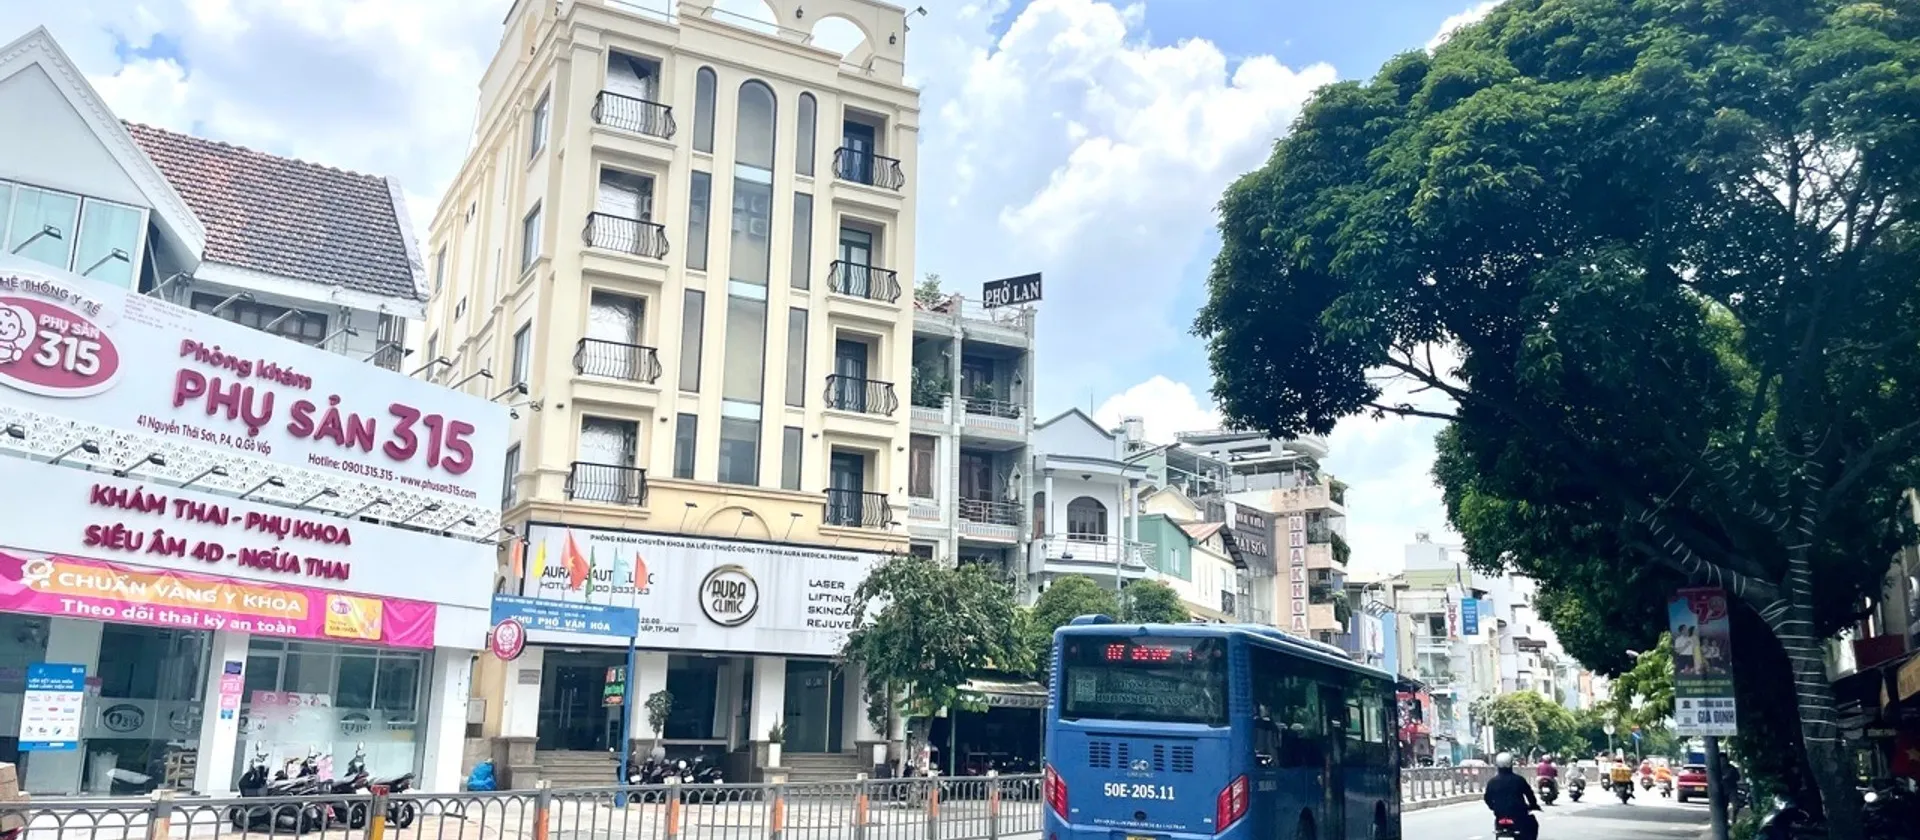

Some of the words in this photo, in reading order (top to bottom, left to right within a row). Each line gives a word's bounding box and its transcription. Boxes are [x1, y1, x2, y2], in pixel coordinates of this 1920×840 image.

[22, 280, 69, 299] THỐNG
[72, 294, 82, 304] Y
[84, 300, 103, 315] TẾ
[985, 280, 1010, 306] PHỞ
[1013, 281, 1039, 301] LAN
[39, 313, 69, 334] PHỤ
[71, 320, 101, 339] SẢN
[33, 330, 101, 376] 315
[179, 338, 252, 378] Phòng
[256, 359, 312, 390] khám
[137, 415, 147, 427] 41
[182, 424, 199, 439] Thái
[256, 440, 272, 456] Vấp
[173, 368, 275, 437] PHỤ
[287, 394, 376, 453] SẢN
[383, 403, 475, 475] 315
[308, 453, 341, 470] Hotline:
[342, 460, 393, 482] 0901.315.315
[400, 475, 477, 499] www.phusan315.com
[90, 483, 166, 517] KHÁM
[173, 499, 229, 526] THAI
[245, 511, 291, 543] PHỤ
[293, 519, 351, 546] KHOA
[83, 522, 143, 552] SIÊU
[148, 529, 188, 557] ÂM
[189, 541, 224, 563] 4D
[304, 558, 350, 581] THAI
[590, 534, 615, 543] PHÒNG
[616, 535, 637, 544] KHÁM
[638, 537, 665, 547] CHUYÊN
[666, 540, 685, 548] KHOA
[685, 541, 695, 549] DA
[737, 544, 756, 554] CÔNG
[757, 547, 765, 555] TY
[765, 547, 783, 556] TNHH
[783, 549, 801, 557] AURA
[801, 551, 828, 560] MEDICAL
[58, 572, 148, 597] CHUẨN
[154, 577, 217, 604] VÀNG
[223, 591, 238, 606] Y
[243, 594, 301, 614] KHOA
[712, 579, 747, 600] AURA
[808, 579, 846, 590] LASER
[808, 592, 852, 604] LIFTING
[60, 598, 118, 617] Theo
[121, 600, 155, 622] dõi
[158, 607, 200, 626] thai
[203, 611, 226, 631] kỳ
[229, 618, 253, 632] an
[256, 618, 298, 634] toàn
[712, 599, 743, 614] CLINIC
[538, 616, 560, 627] PHỐ
[590, 620, 611, 632] HÓA
[1697, 710, 1712, 724] GIA
[1104, 782, 1175, 800] 50E-205.11
